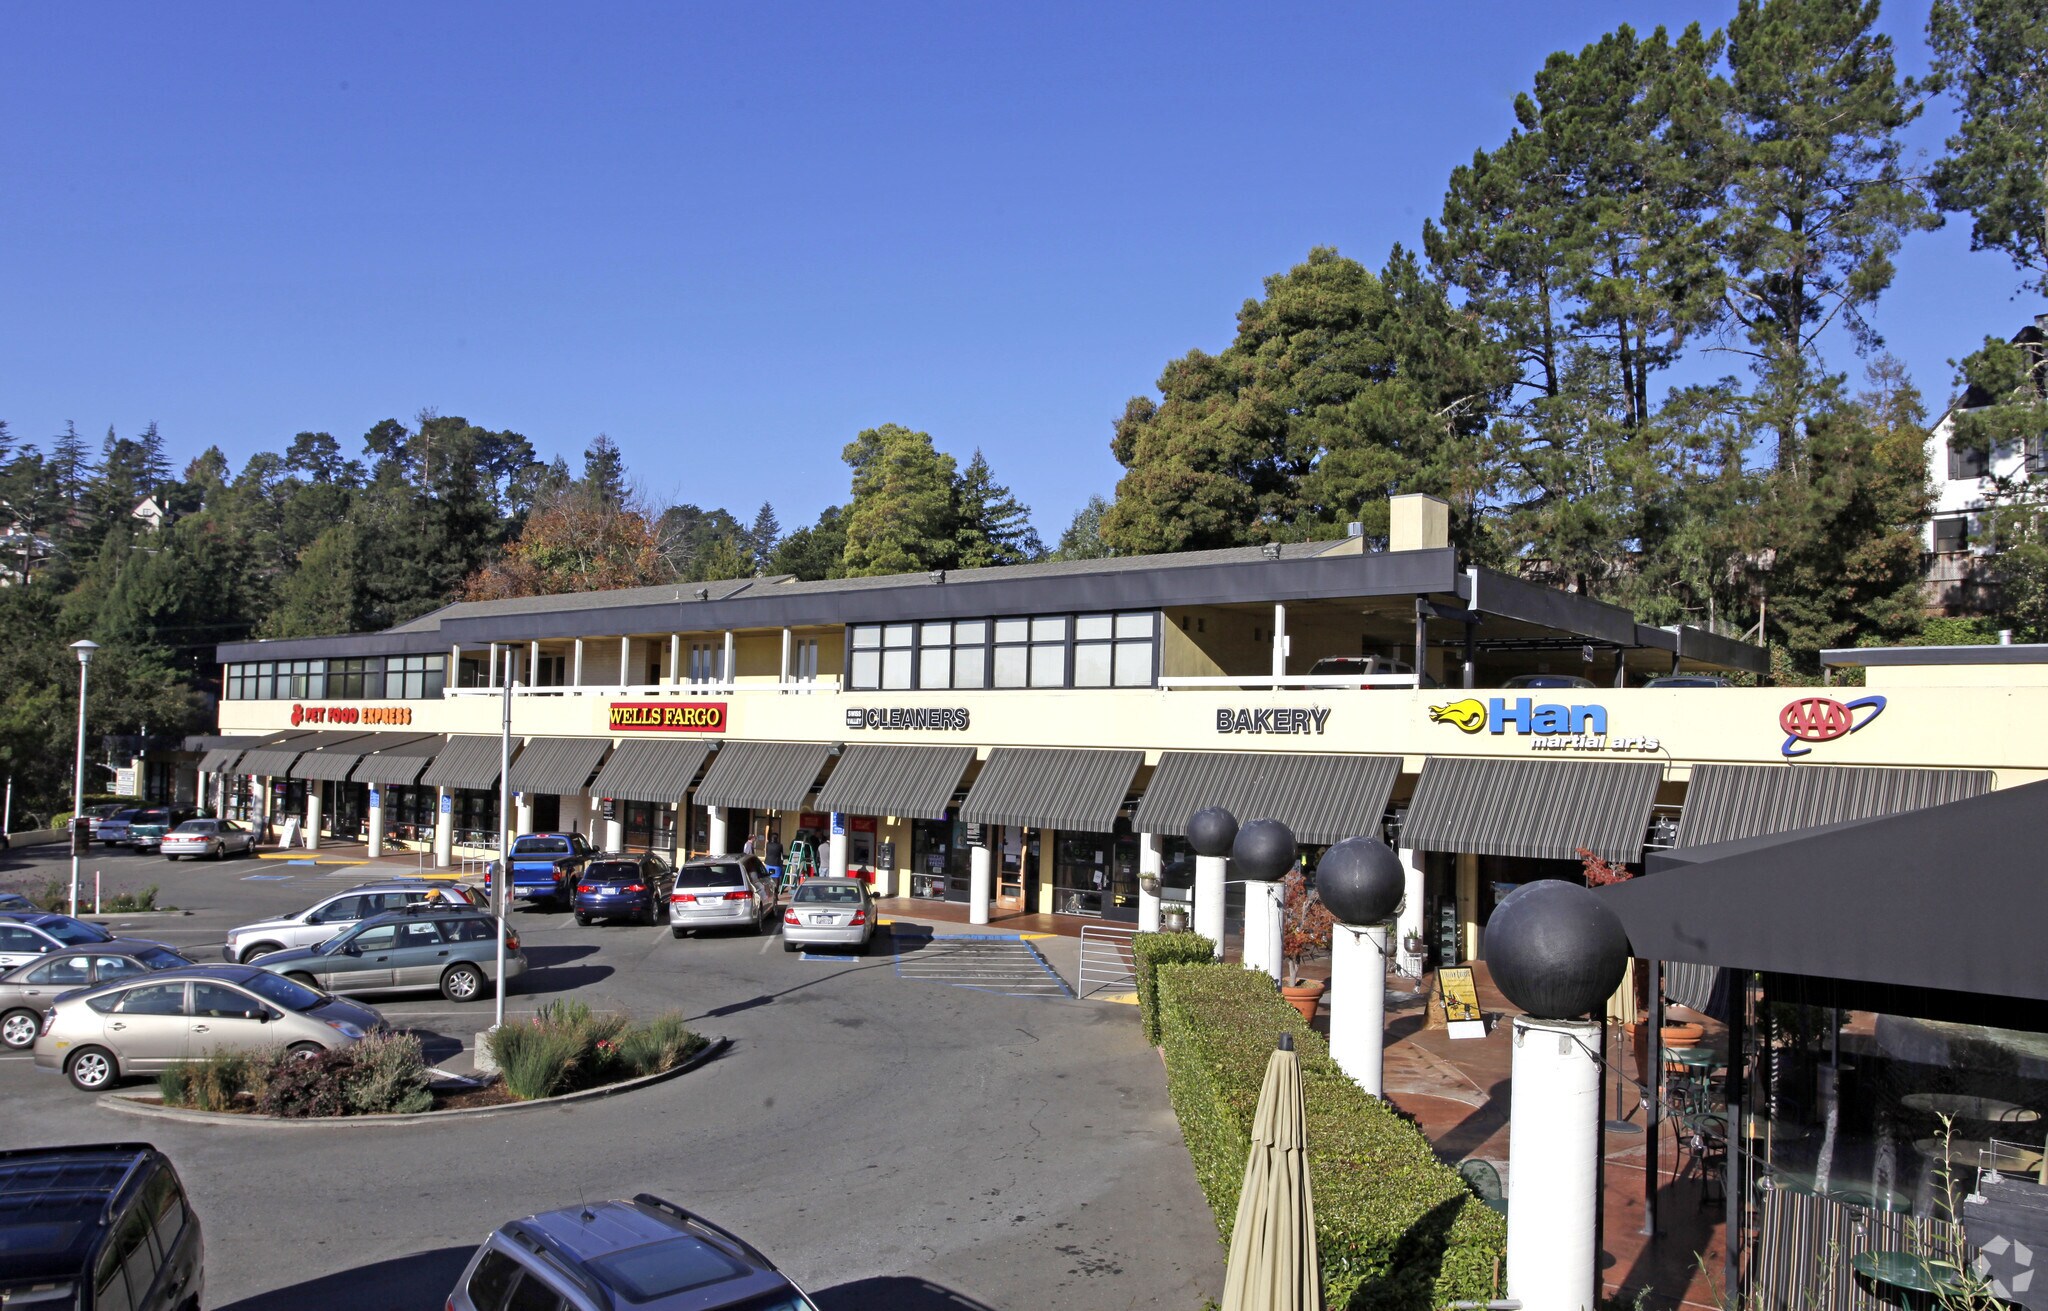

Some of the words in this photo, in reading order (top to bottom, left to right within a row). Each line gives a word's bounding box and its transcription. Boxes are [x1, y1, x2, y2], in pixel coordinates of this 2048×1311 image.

[305, 707, 326, 723] PET
[328, 707, 359, 724] FOOD
[361, 707, 412, 725] EXPRESS
[608, 707, 662, 725] WELLS
[663, 708, 722, 727] FARGO
[866, 707, 970, 731] CLEANERS
[1216, 708, 1331, 734] BAKERY
[1489, 698, 1607, 735] Han
[1787, 699, 1843, 738] AAA
[1531, 734, 1606, 751] martial
[1611, 736, 1660, 752] arts
